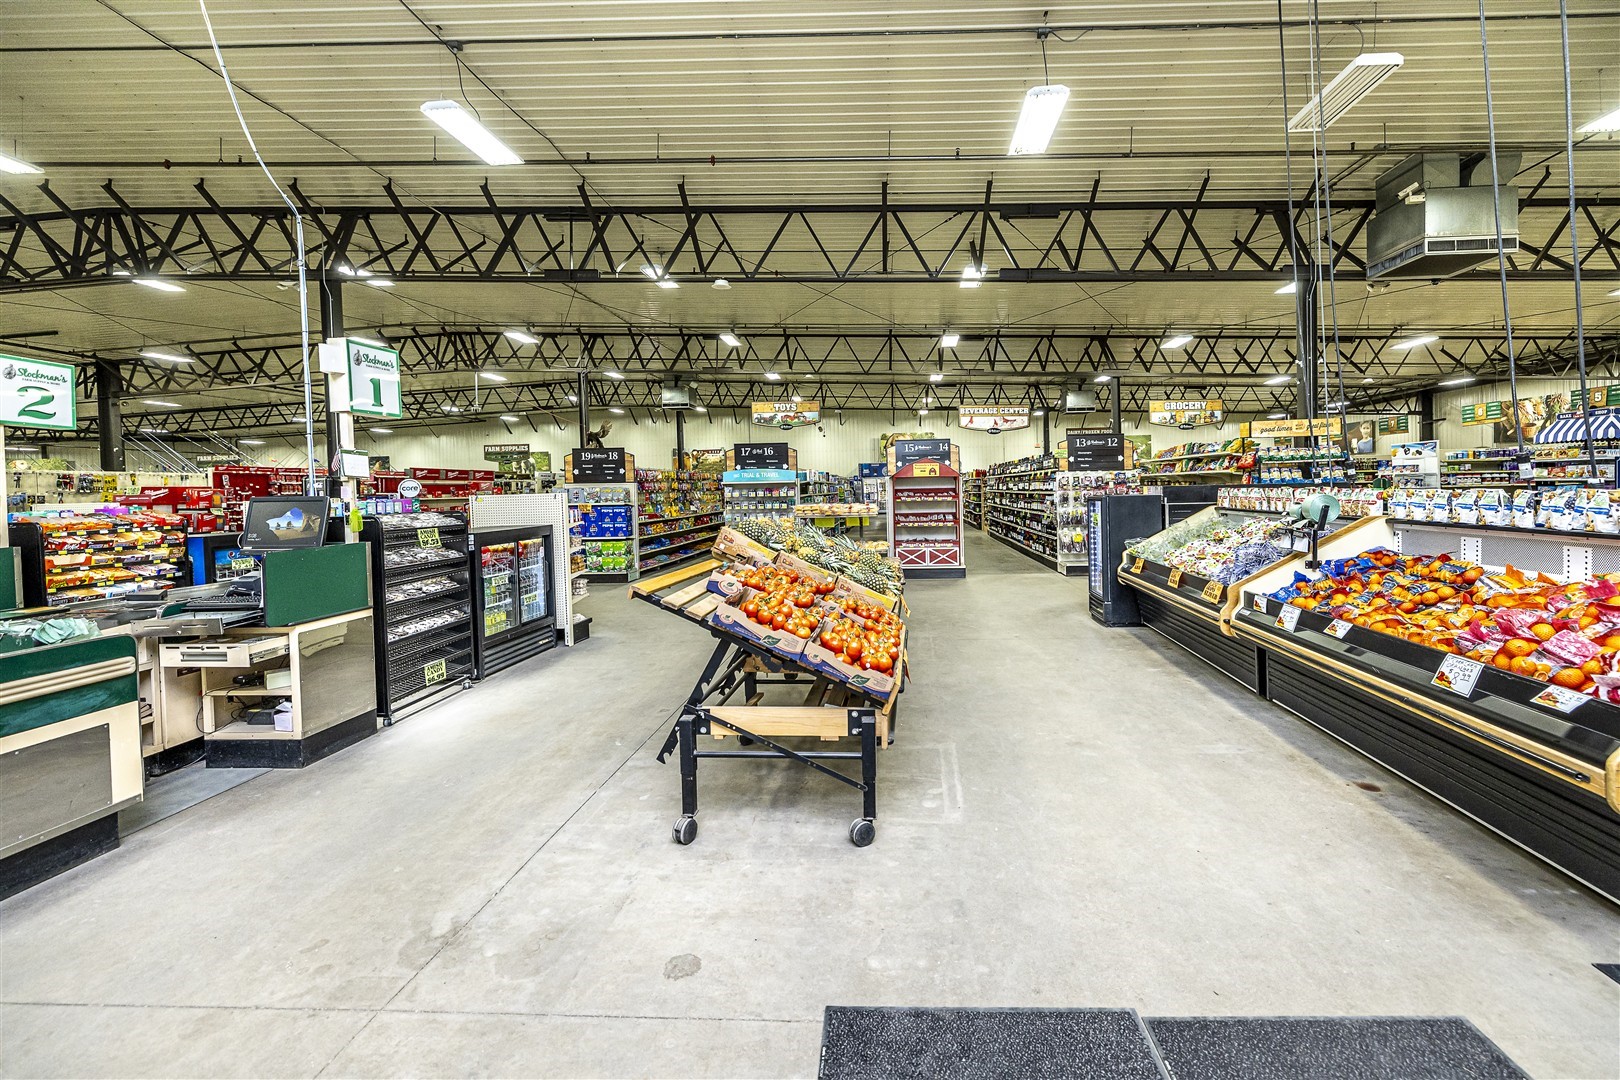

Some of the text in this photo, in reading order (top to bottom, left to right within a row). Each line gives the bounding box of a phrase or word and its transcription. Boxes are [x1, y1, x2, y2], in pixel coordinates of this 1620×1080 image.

[363, 354, 394, 368] Stockman's
[17, 368, 68, 383] Stockman's
[369, 378, 384, 407] 1
[1594, 393, 1602, 402] 5
[17, 386, 56, 419] 2
[774, 403, 797, 411] TOYS
[1165, 401, 1207, 410] GROCERY
[1477, 407, 1483, 416] 6
[1260, 426, 1276, 434] good
[1076, 438, 1086, 447] 13
[1107, 437, 1118, 447] 12
[484, 444, 528, 452] FARM SUPPLIES
[741, 447, 751, 456] 17
[763, 447, 774, 456] 16
[905, 444, 914, 452] 15
[939, 443, 949, 452] 14
[581, 452, 591, 460] 19
[608, 451, 618, 460] 18
[723, 535, 734, 544] Dole
[782, 558, 794, 567] Dole
[840, 583, 851, 592] Dole
[427, 661, 443, 671] AMISH
[427, 666, 443, 676] CANDY
[427, 672, 444, 684] $6.99
